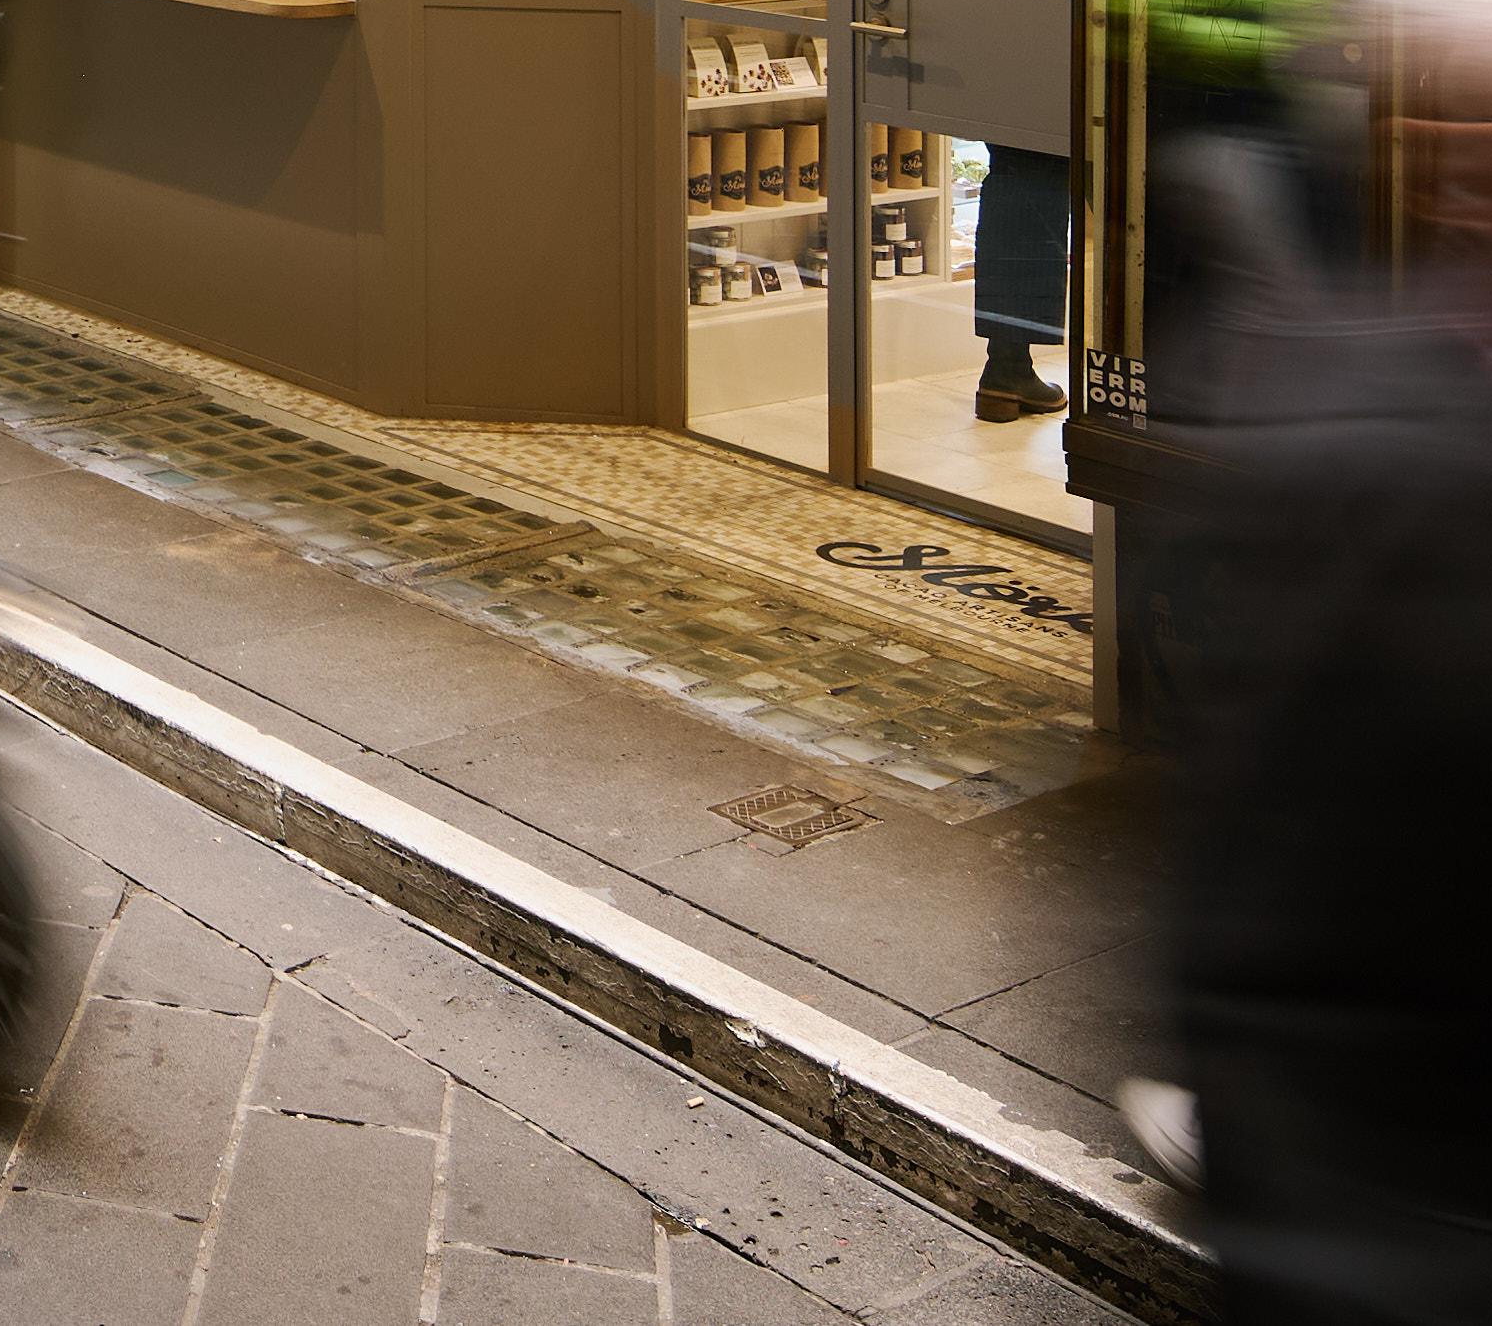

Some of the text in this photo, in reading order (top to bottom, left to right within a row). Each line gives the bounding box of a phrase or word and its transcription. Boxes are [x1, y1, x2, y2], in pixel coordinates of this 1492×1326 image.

[1090, 351, 1145, 376] VIP
[874, 573, 1068, 638] CACAO ARTISANS
[914, 594, 1031, 635] MELBOURNE
